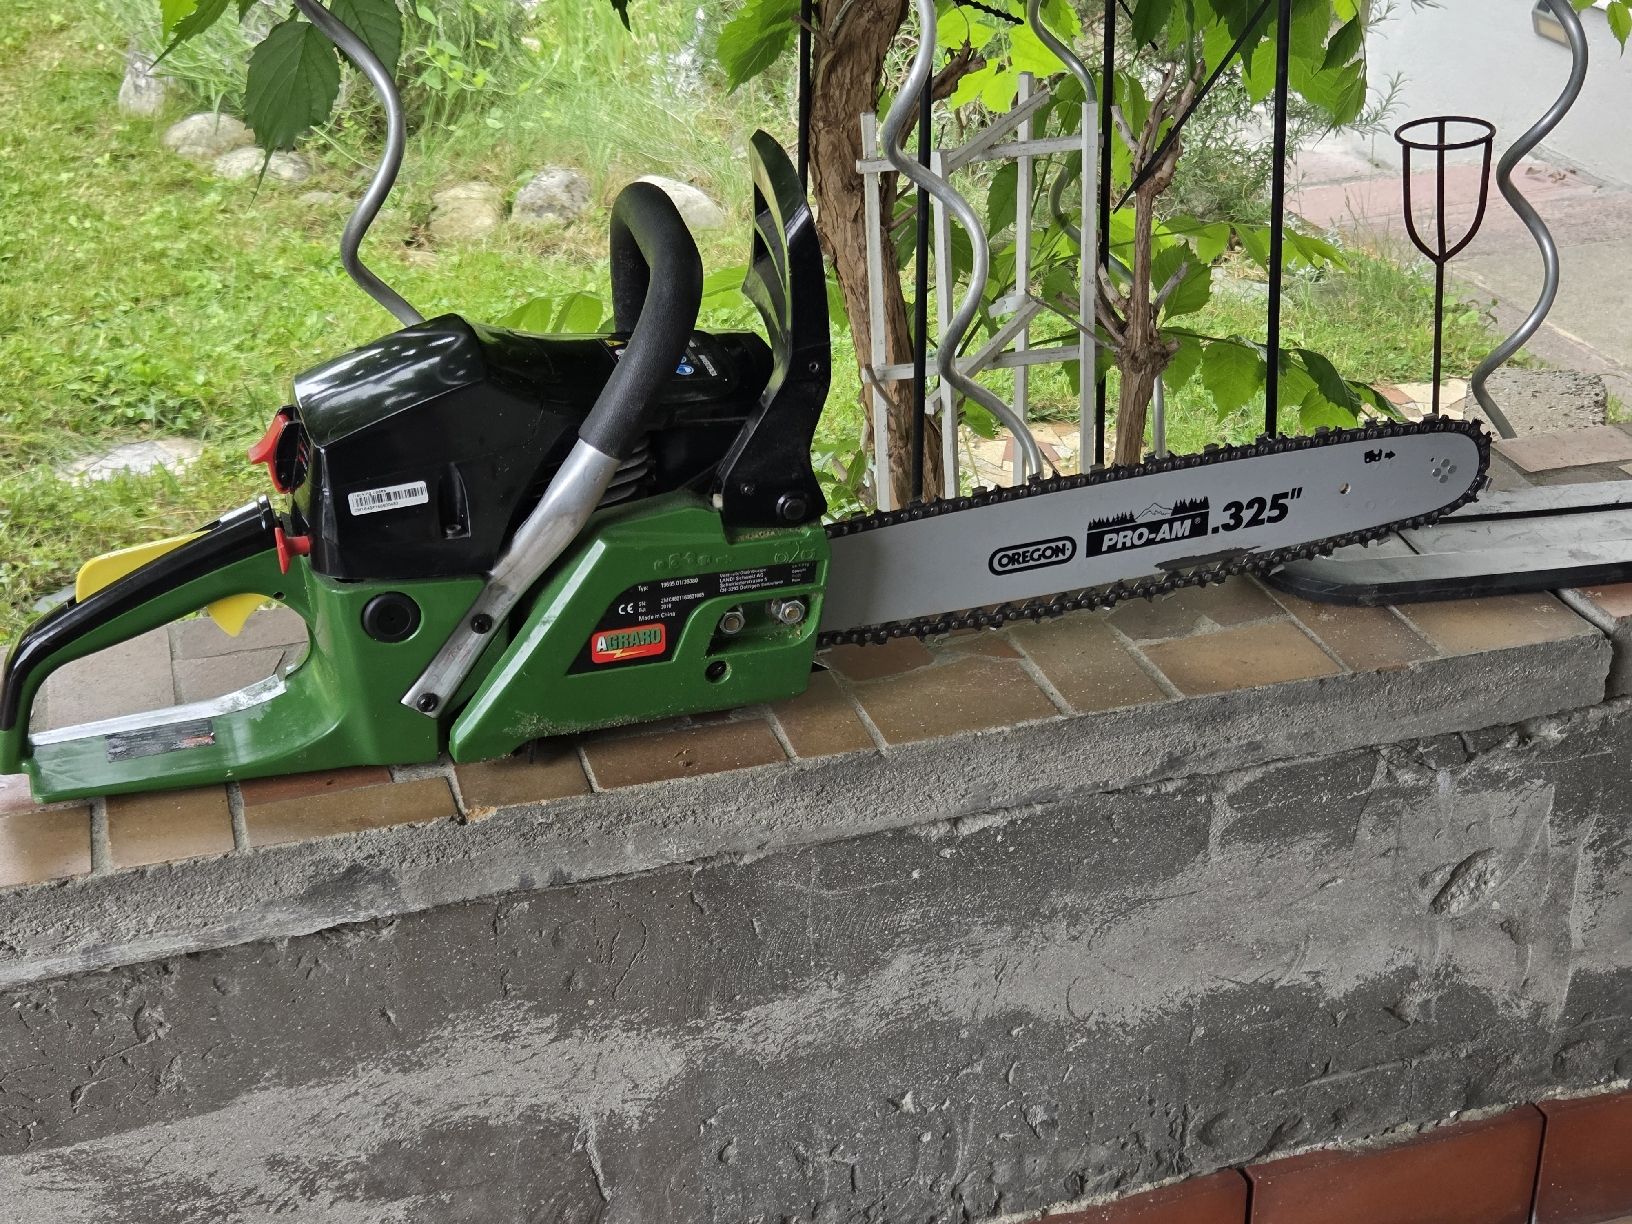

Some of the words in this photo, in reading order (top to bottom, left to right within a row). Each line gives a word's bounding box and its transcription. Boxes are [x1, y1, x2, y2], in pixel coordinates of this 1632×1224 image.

[1102, 519, 1192, 552] PRO-AM
[998, 543, 1067, 568] OREGON
[638, 614, 654, 622] Made
